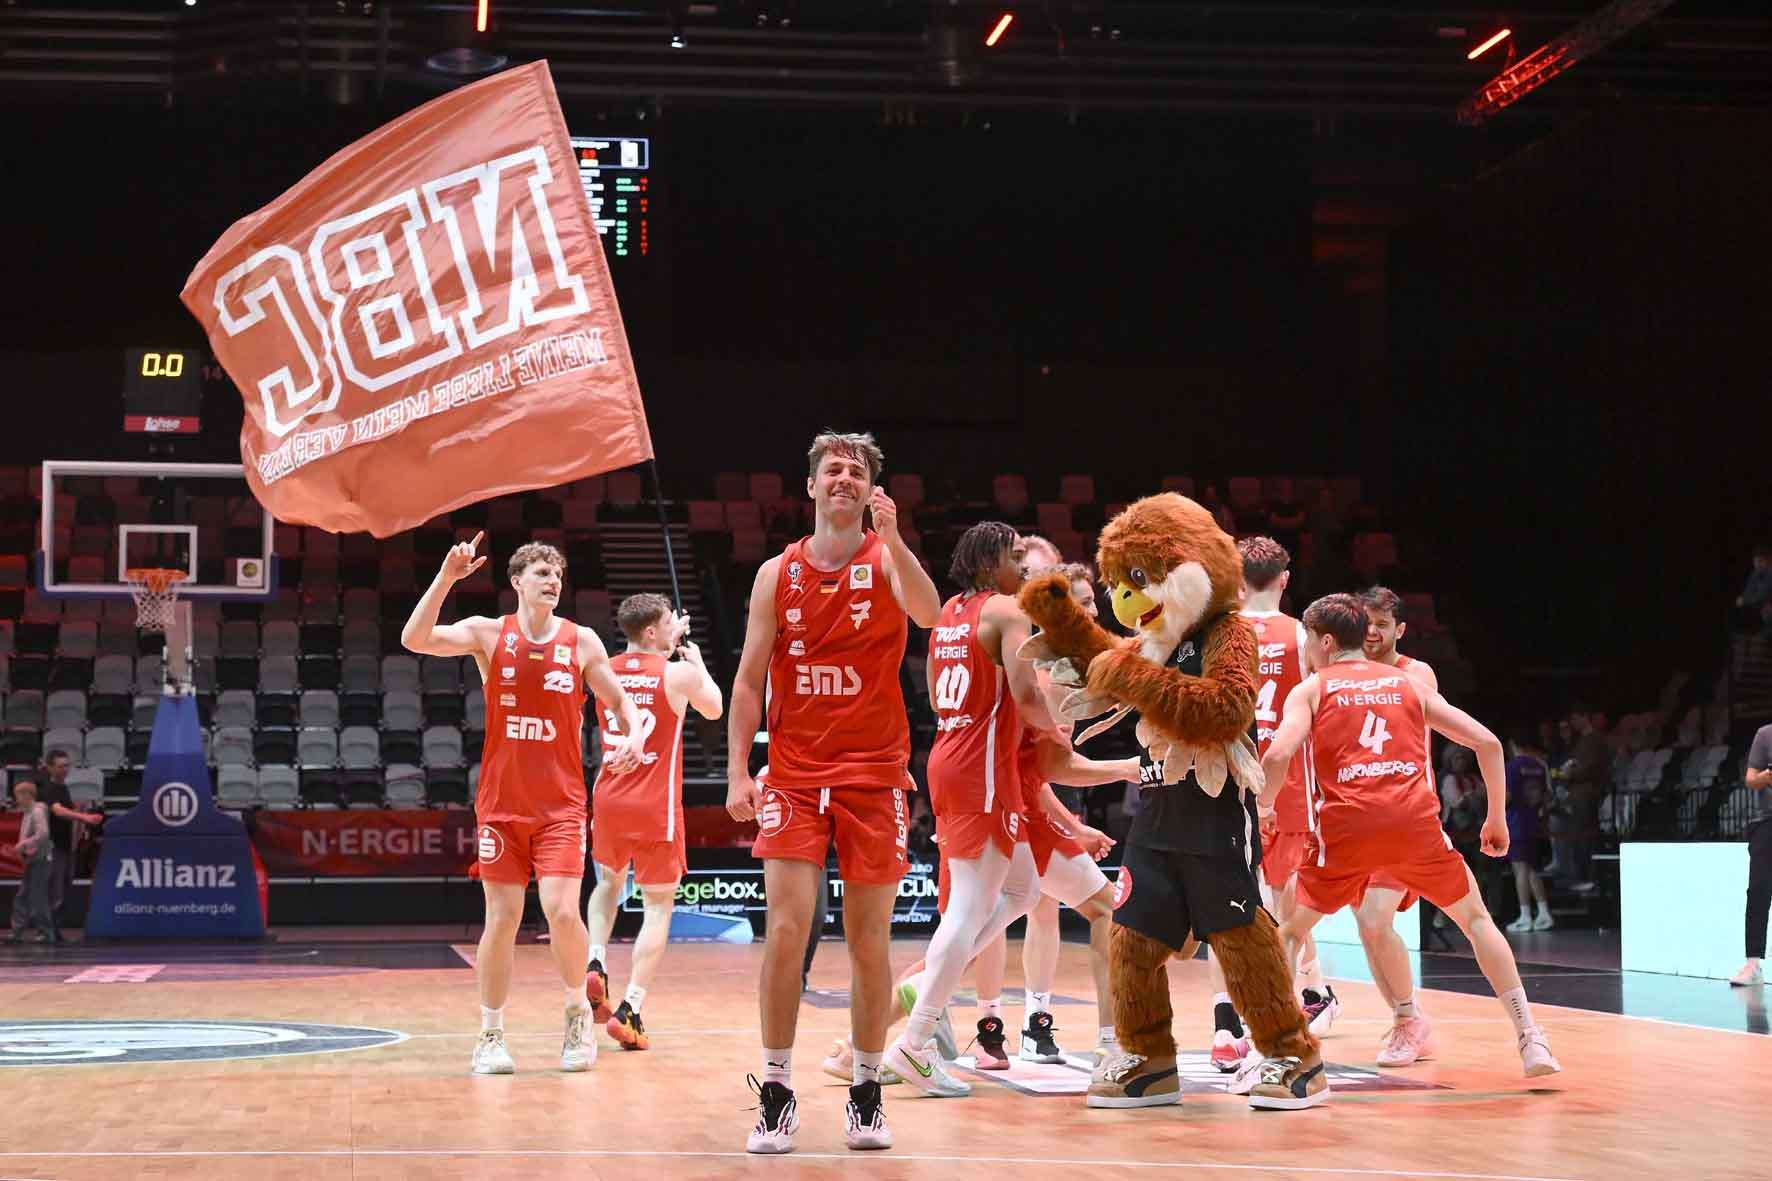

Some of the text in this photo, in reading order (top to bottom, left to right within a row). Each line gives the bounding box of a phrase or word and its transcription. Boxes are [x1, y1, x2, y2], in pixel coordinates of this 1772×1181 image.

[142, 353, 184, 377] 0.0
[850, 600, 872, 630] 7
[795, 664, 862, 696] EMS
[506, 715, 557, 742] EMS
[1358, 709, 1392, 755] 4
[115, 859, 236, 888] Allianz
